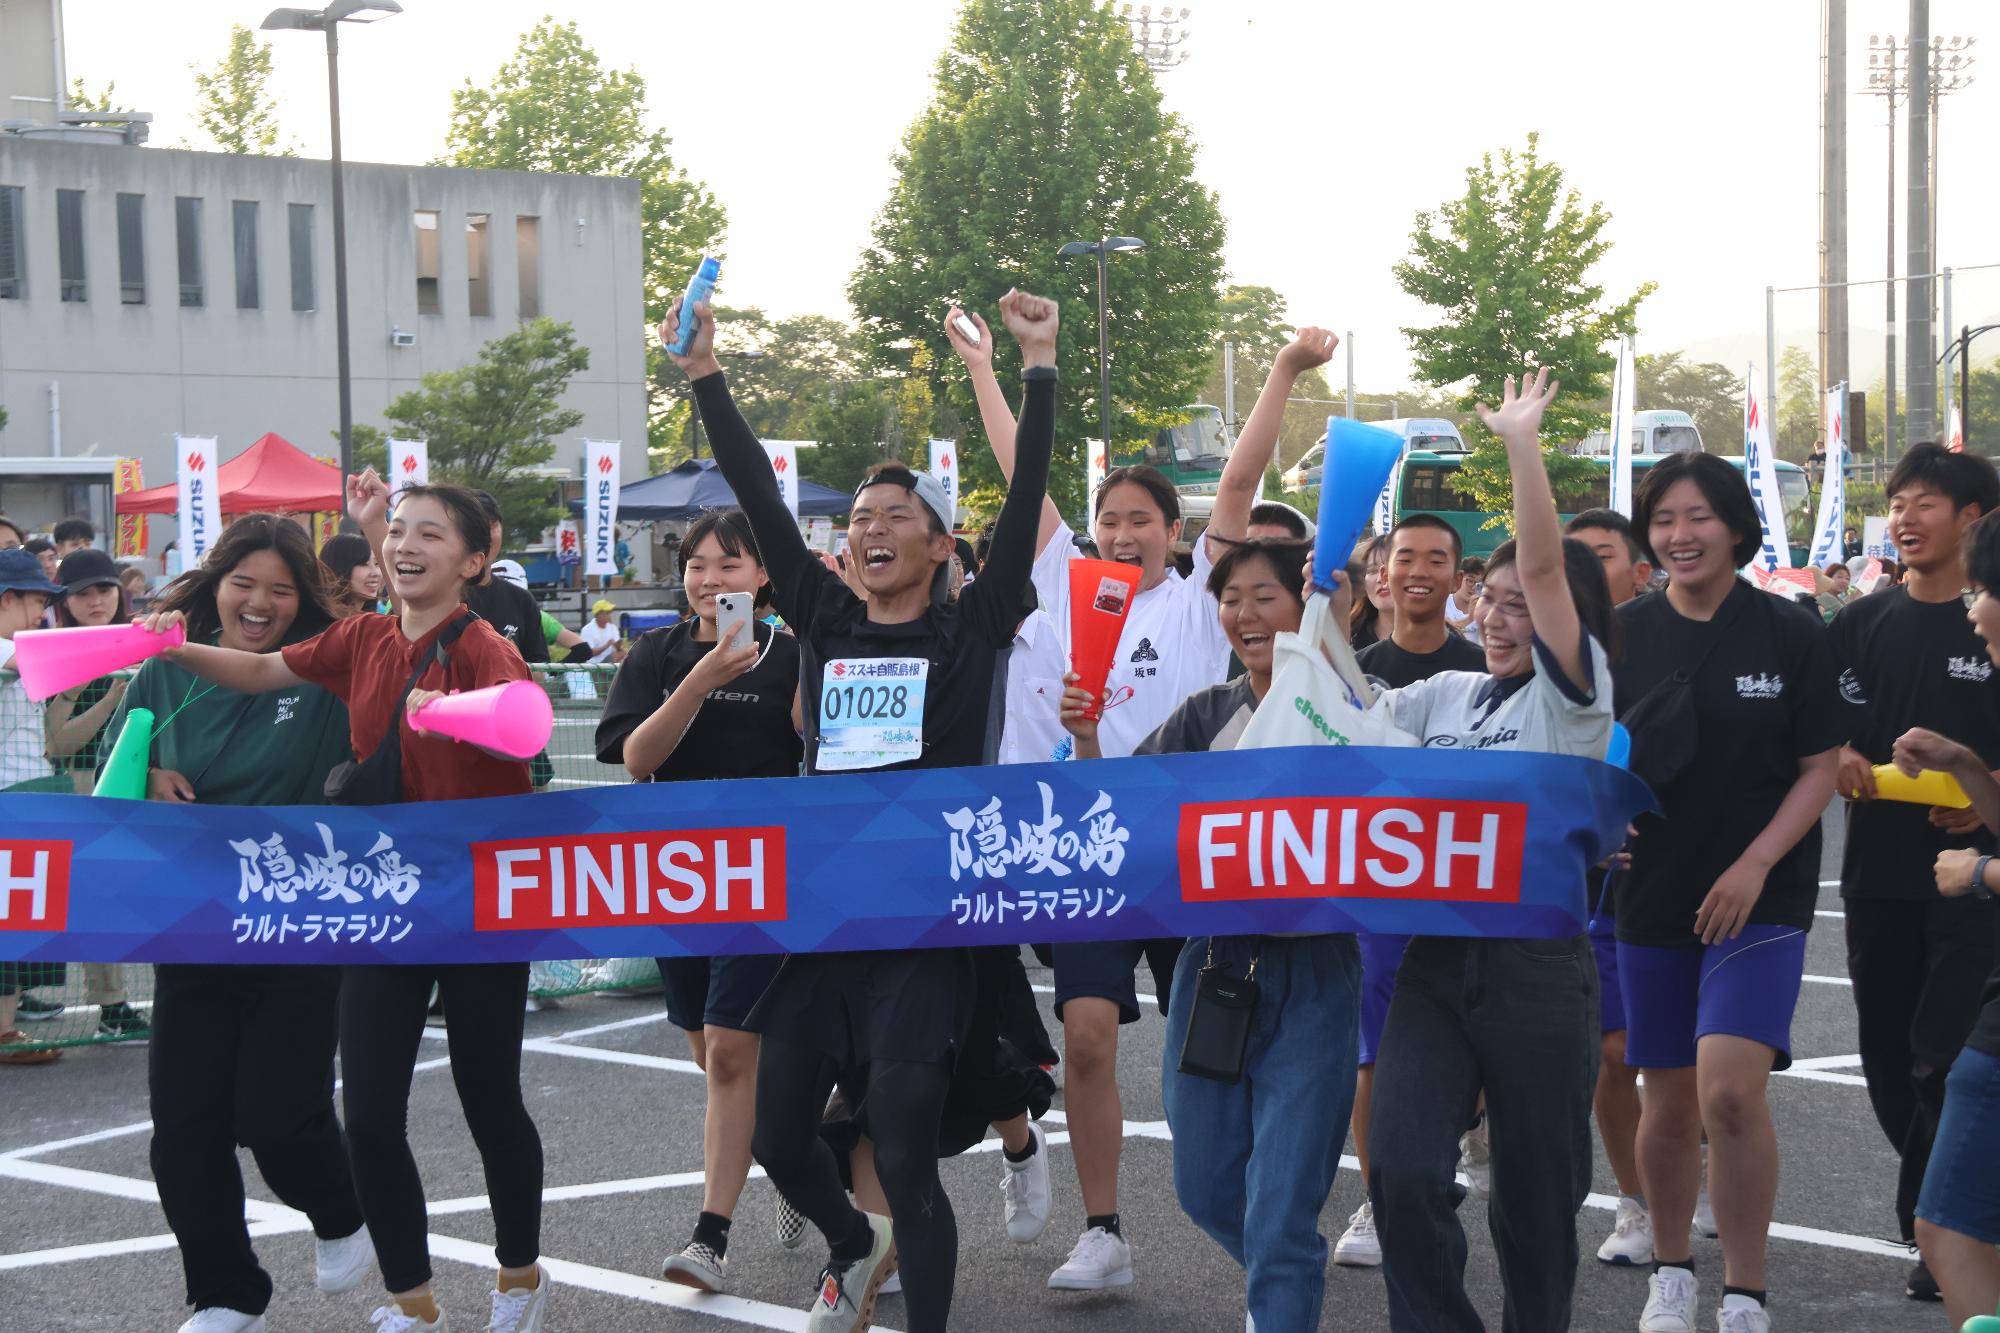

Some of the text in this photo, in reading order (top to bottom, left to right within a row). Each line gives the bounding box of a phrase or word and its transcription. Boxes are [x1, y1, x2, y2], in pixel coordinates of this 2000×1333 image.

[597, 480, 610, 563] SUZUKI
[825, 685, 908, 720] 01028
[1295, 696, 1351, 746] cheers
[228, 821, 421, 905] 隠岐の島
[942, 781, 1130, 882] 隠岐の島
[1199, 808, 1500, 890] FINISH
[0, 850, 50, 921] H
[495, 838, 765, 919] FINISH
[951, 887, 1126, 925] ウルトラマラソン
[232, 912, 413, 944] ウルトラマラソン
